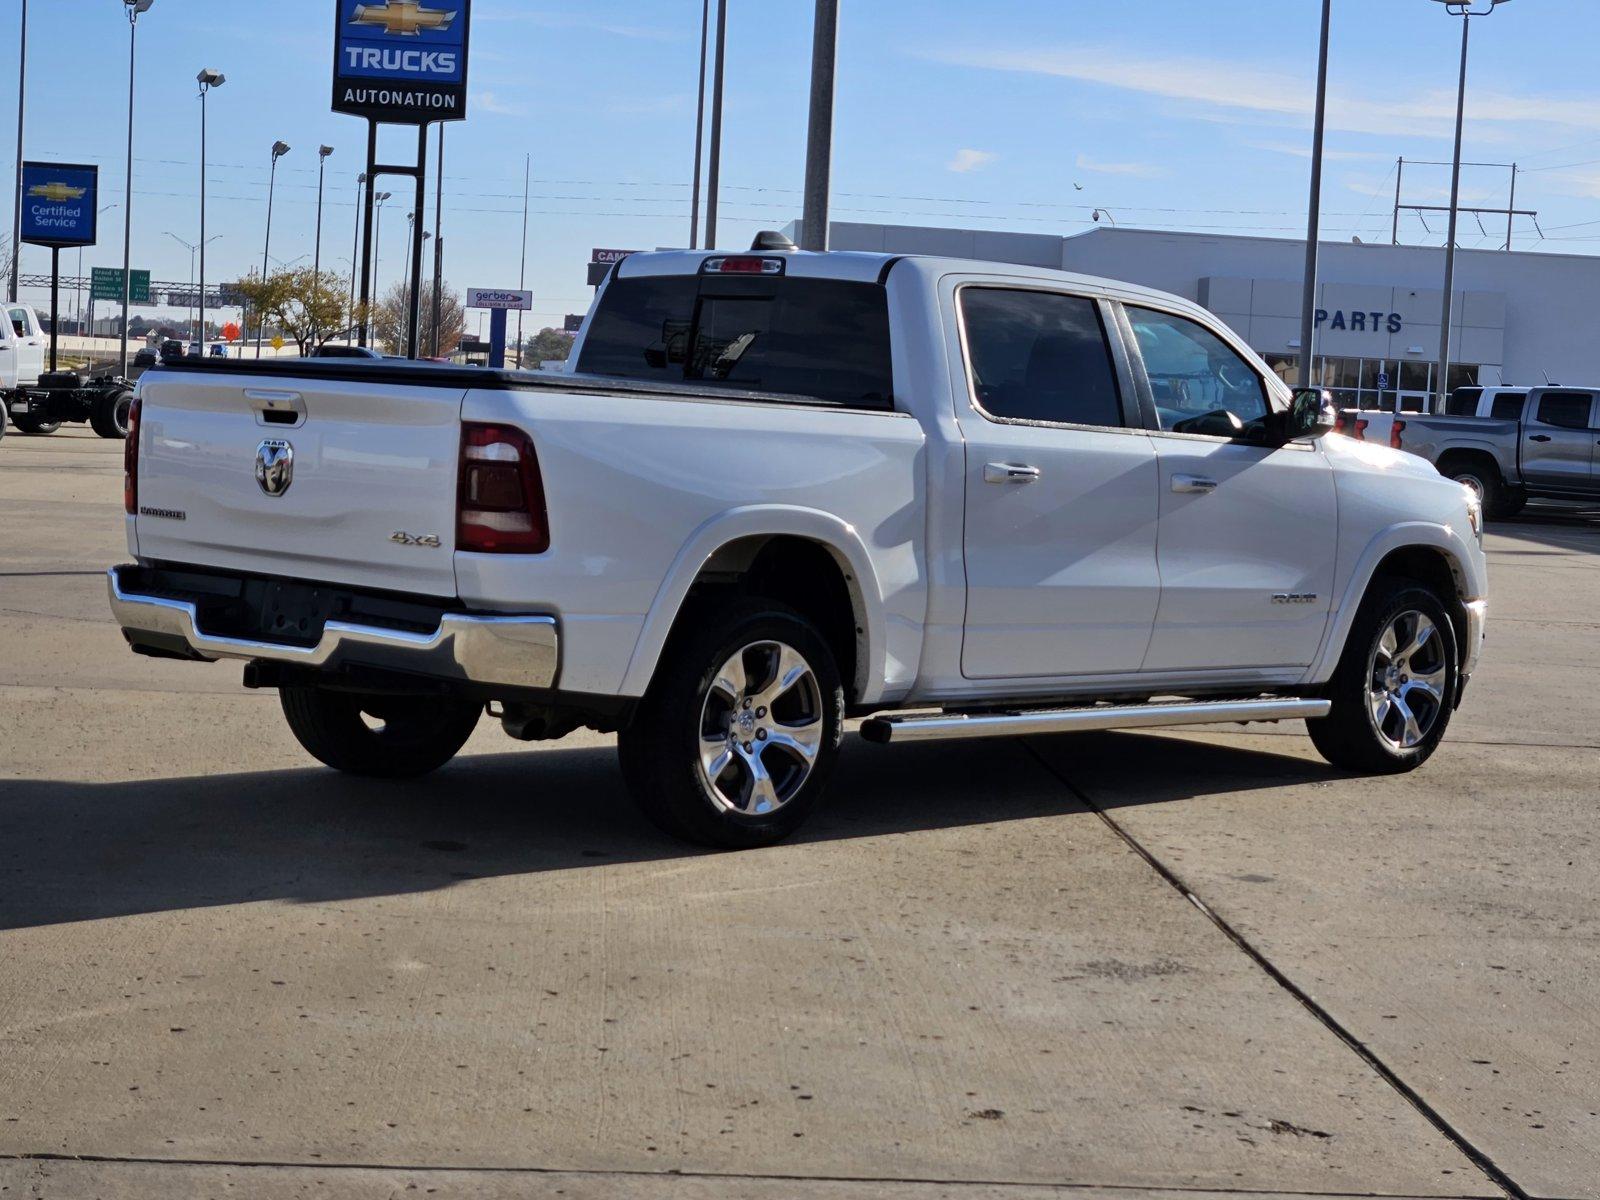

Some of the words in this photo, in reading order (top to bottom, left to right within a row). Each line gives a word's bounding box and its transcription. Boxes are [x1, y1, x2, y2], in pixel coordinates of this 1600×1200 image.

[345, 46, 456, 74] TRUCKS
[344, 88, 456, 108] AUTONATION
[32, 204, 80, 217] Certified
[35, 216, 76, 227] Service
[476, 291, 512, 301] gerber
[1313, 308, 1402, 333] PARTS
[391, 530, 442, 548] 4x4
